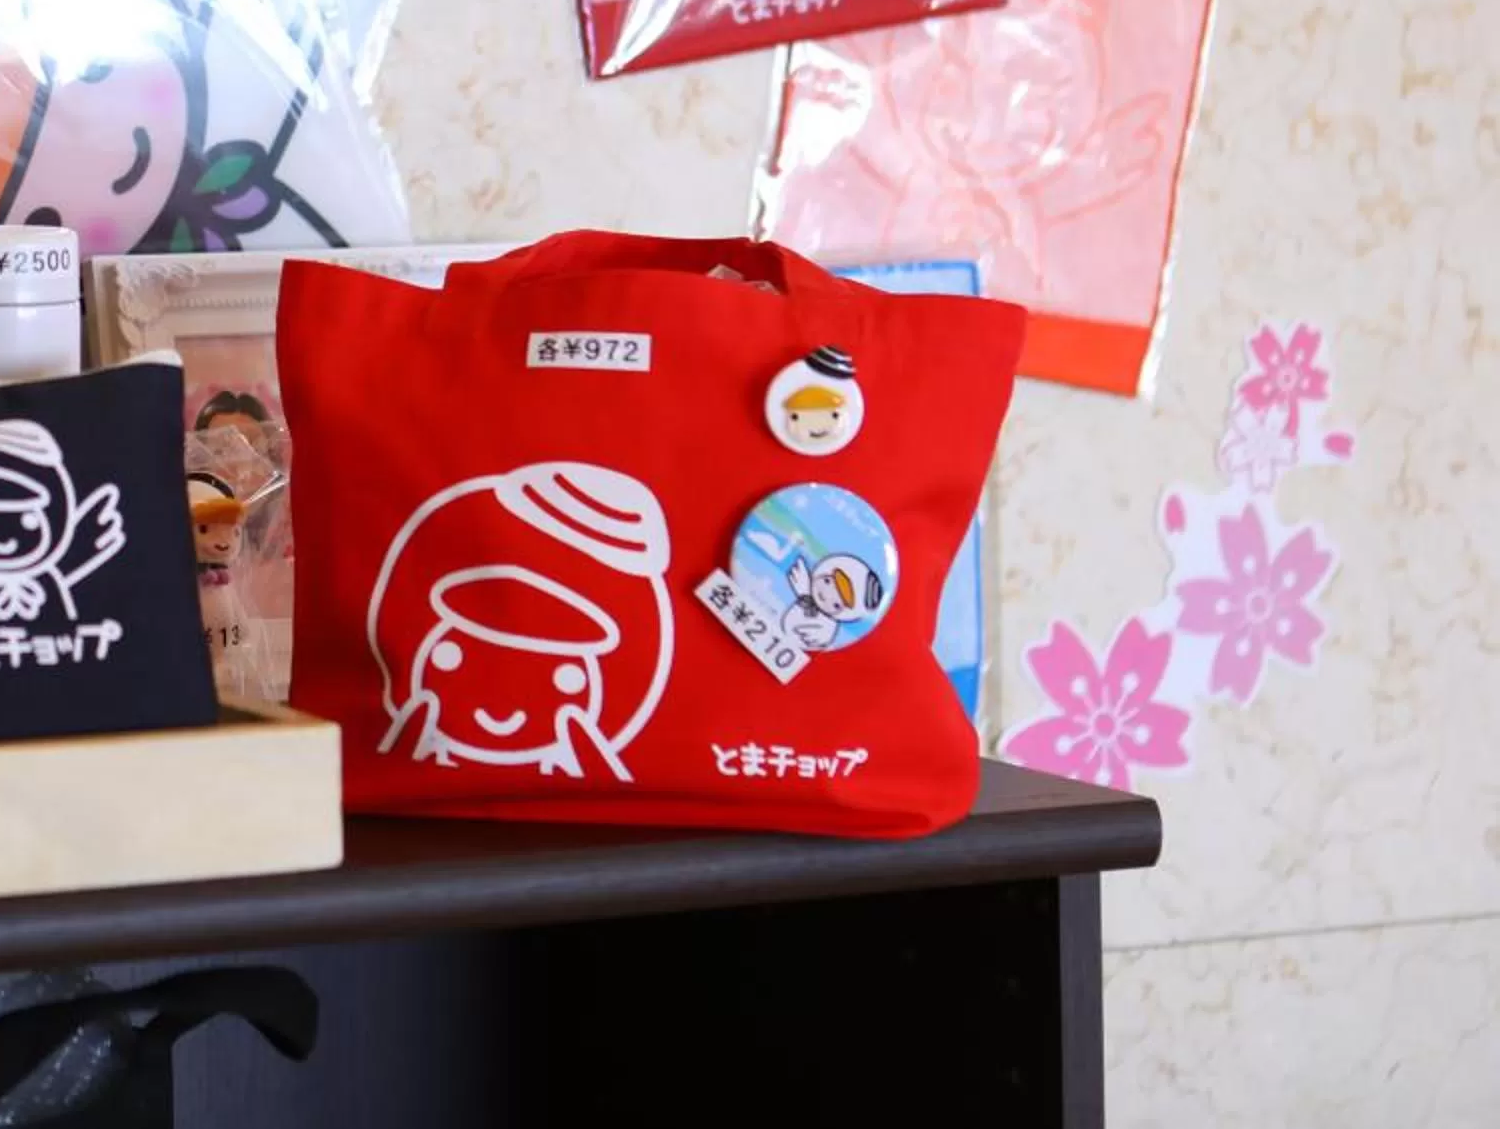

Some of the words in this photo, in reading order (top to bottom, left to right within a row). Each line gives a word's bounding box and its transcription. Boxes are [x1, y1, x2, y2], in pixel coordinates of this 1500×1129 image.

[536, 337, 641, 363] 各¥972
[708, 583, 797, 670] 各¥210
[711, 741, 870, 779] とまチョップ
